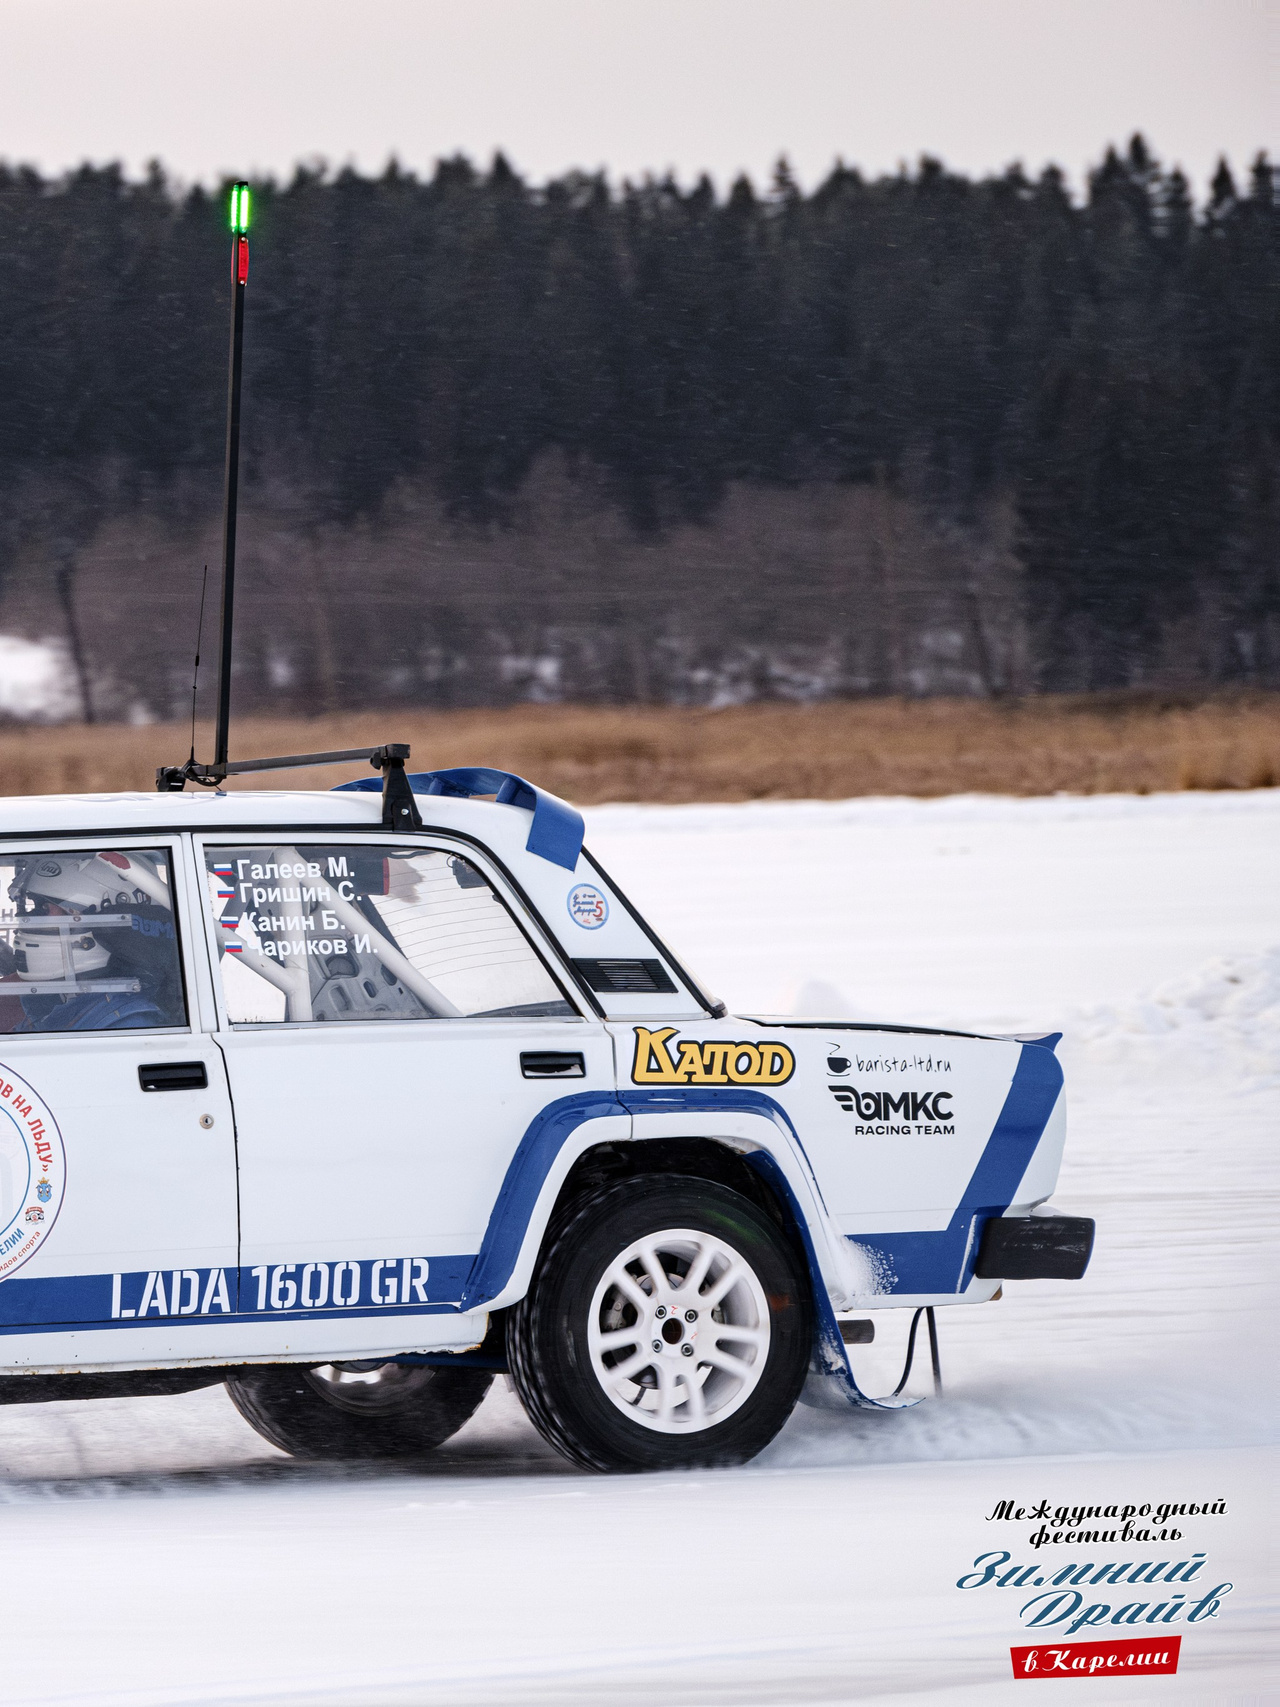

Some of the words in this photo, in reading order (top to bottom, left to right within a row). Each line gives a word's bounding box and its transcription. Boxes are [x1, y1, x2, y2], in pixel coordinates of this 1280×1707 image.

[237, 859, 321, 880] Галеев
[328, 856, 355, 878] М.
[239, 882, 330, 908] Гришин
[338, 881, 362, 901] С.
[242, 911, 315, 932] Канин
[321, 910, 346, 930] Б.
[354, 933, 378, 954] И.
[856, 1054, 952, 1073] barista-ltd.ru
[11, 1094, 33, 1118] НА
[27, 1119, 53, 1172] ЛЬДУ»
[855, 1125, 911, 1135] RACING
[915, 1125, 955, 1135] TEAM
[18, 1231, 41, 1258] спорта
[111, 1268, 231, 1319] LADA
[251, 1261, 361, 1310] 1600
[371, 1258, 430, 1305] GR
